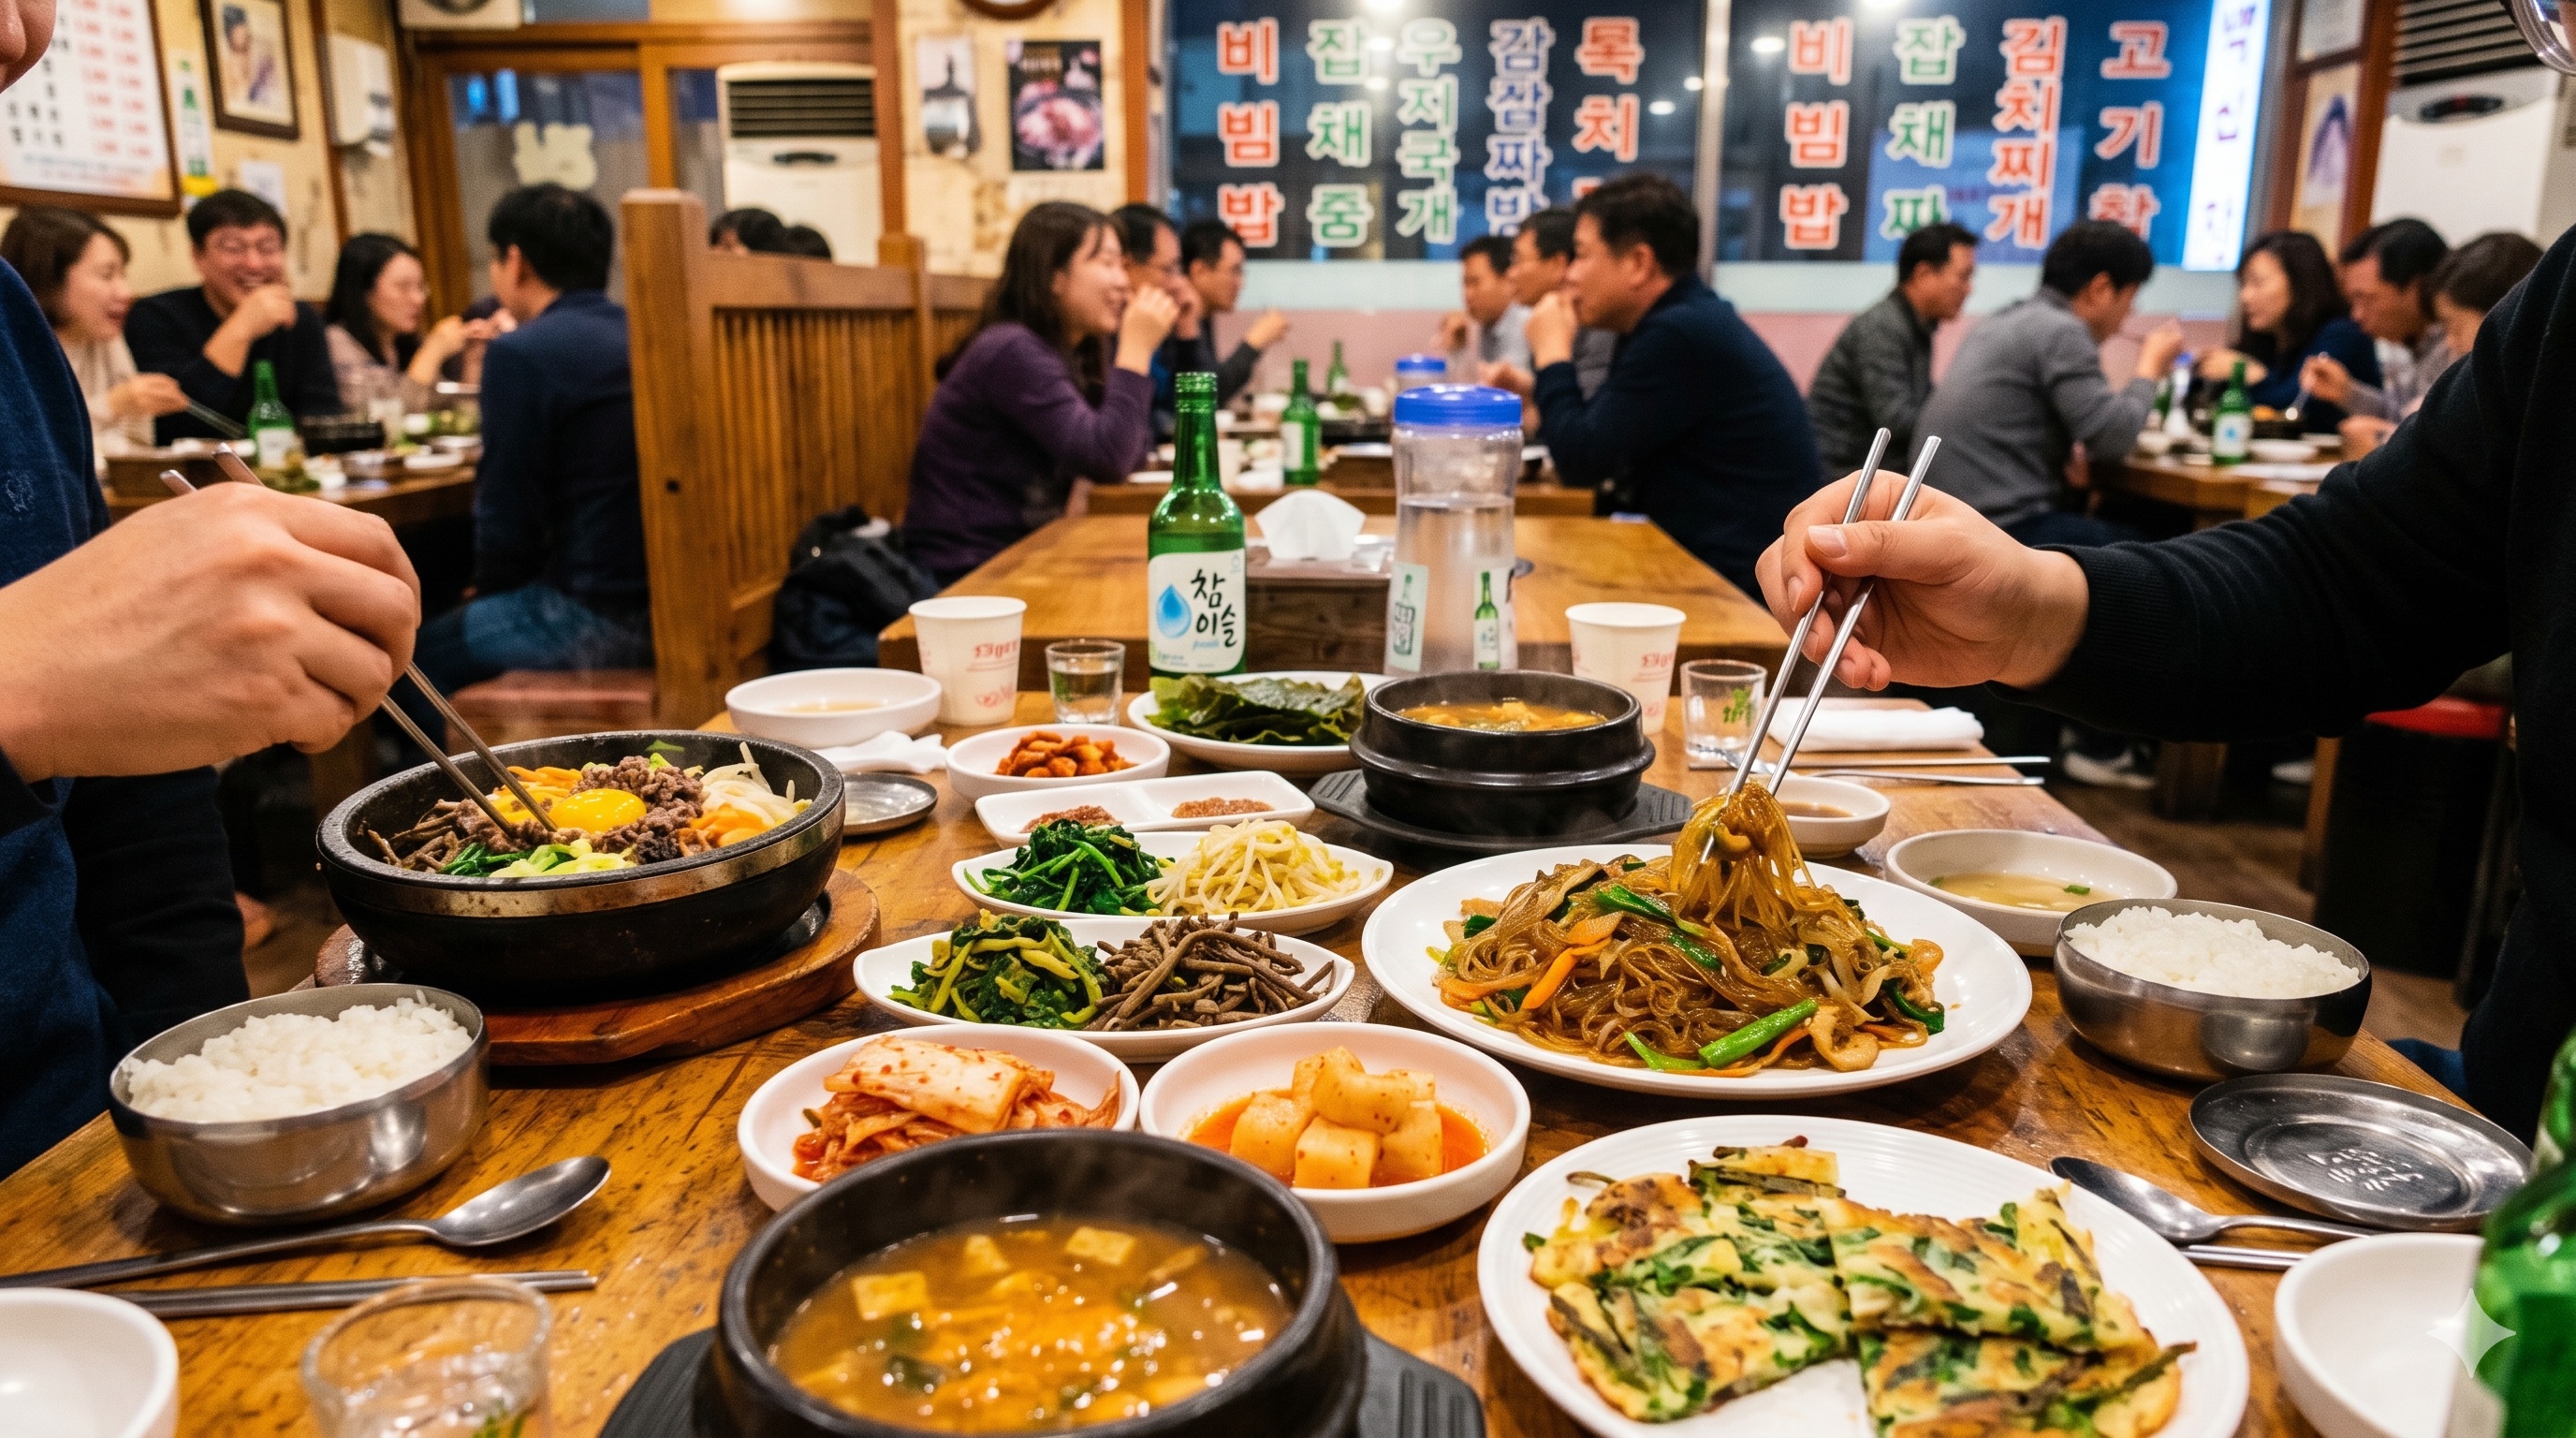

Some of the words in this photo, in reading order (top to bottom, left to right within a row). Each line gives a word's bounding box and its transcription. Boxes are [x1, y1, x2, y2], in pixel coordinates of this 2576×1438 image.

[1218, 18, 1284, 247] 비빔밥
[1779, 16, 1853, 249] 비빔밥
[1985, 16, 2067, 248] 김치찌개
[1190, 568, 1226, 609] 참
[1195, 603, 1237, 648] 이슬
